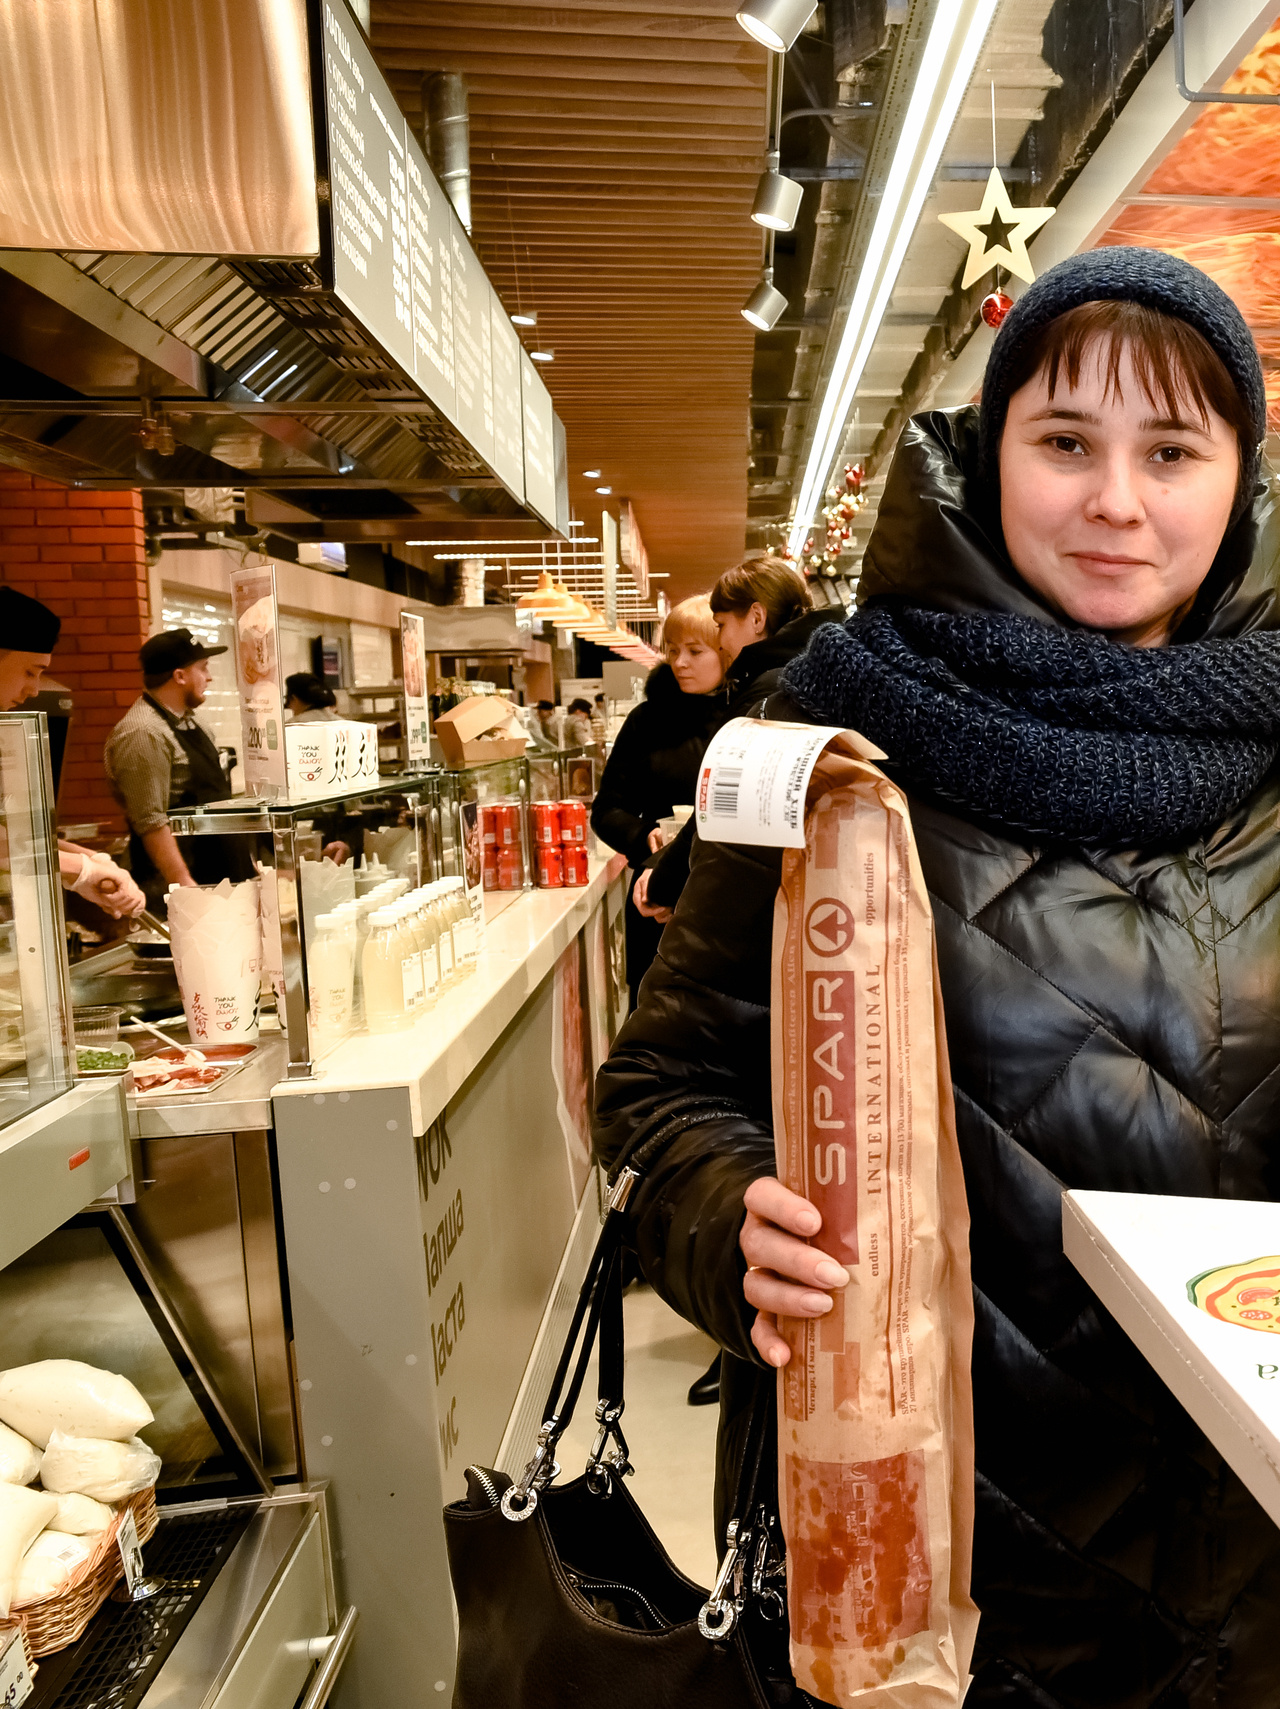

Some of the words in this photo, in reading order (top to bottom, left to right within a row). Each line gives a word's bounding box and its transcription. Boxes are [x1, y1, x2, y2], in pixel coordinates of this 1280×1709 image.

[325, 4, 352, 69] ЛАПША
[332, 60, 357, 115] курицей
[337, 101, 365, 157] свининой
[700, 777, 709, 812] SPAR
[864, 851, 875, 926] opportunities
[787, 945, 796, 984] Allen
[813, 976, 847, 1187] SPAR
[866, 963, 882, 1196] INTERNATIONAL
[868, 1232, 880, 1278] endless
[808, 1365, 815, 1374] 14
[439, 1395, 459, 1471] ис
[910, 1404, 917, 1413] 27
